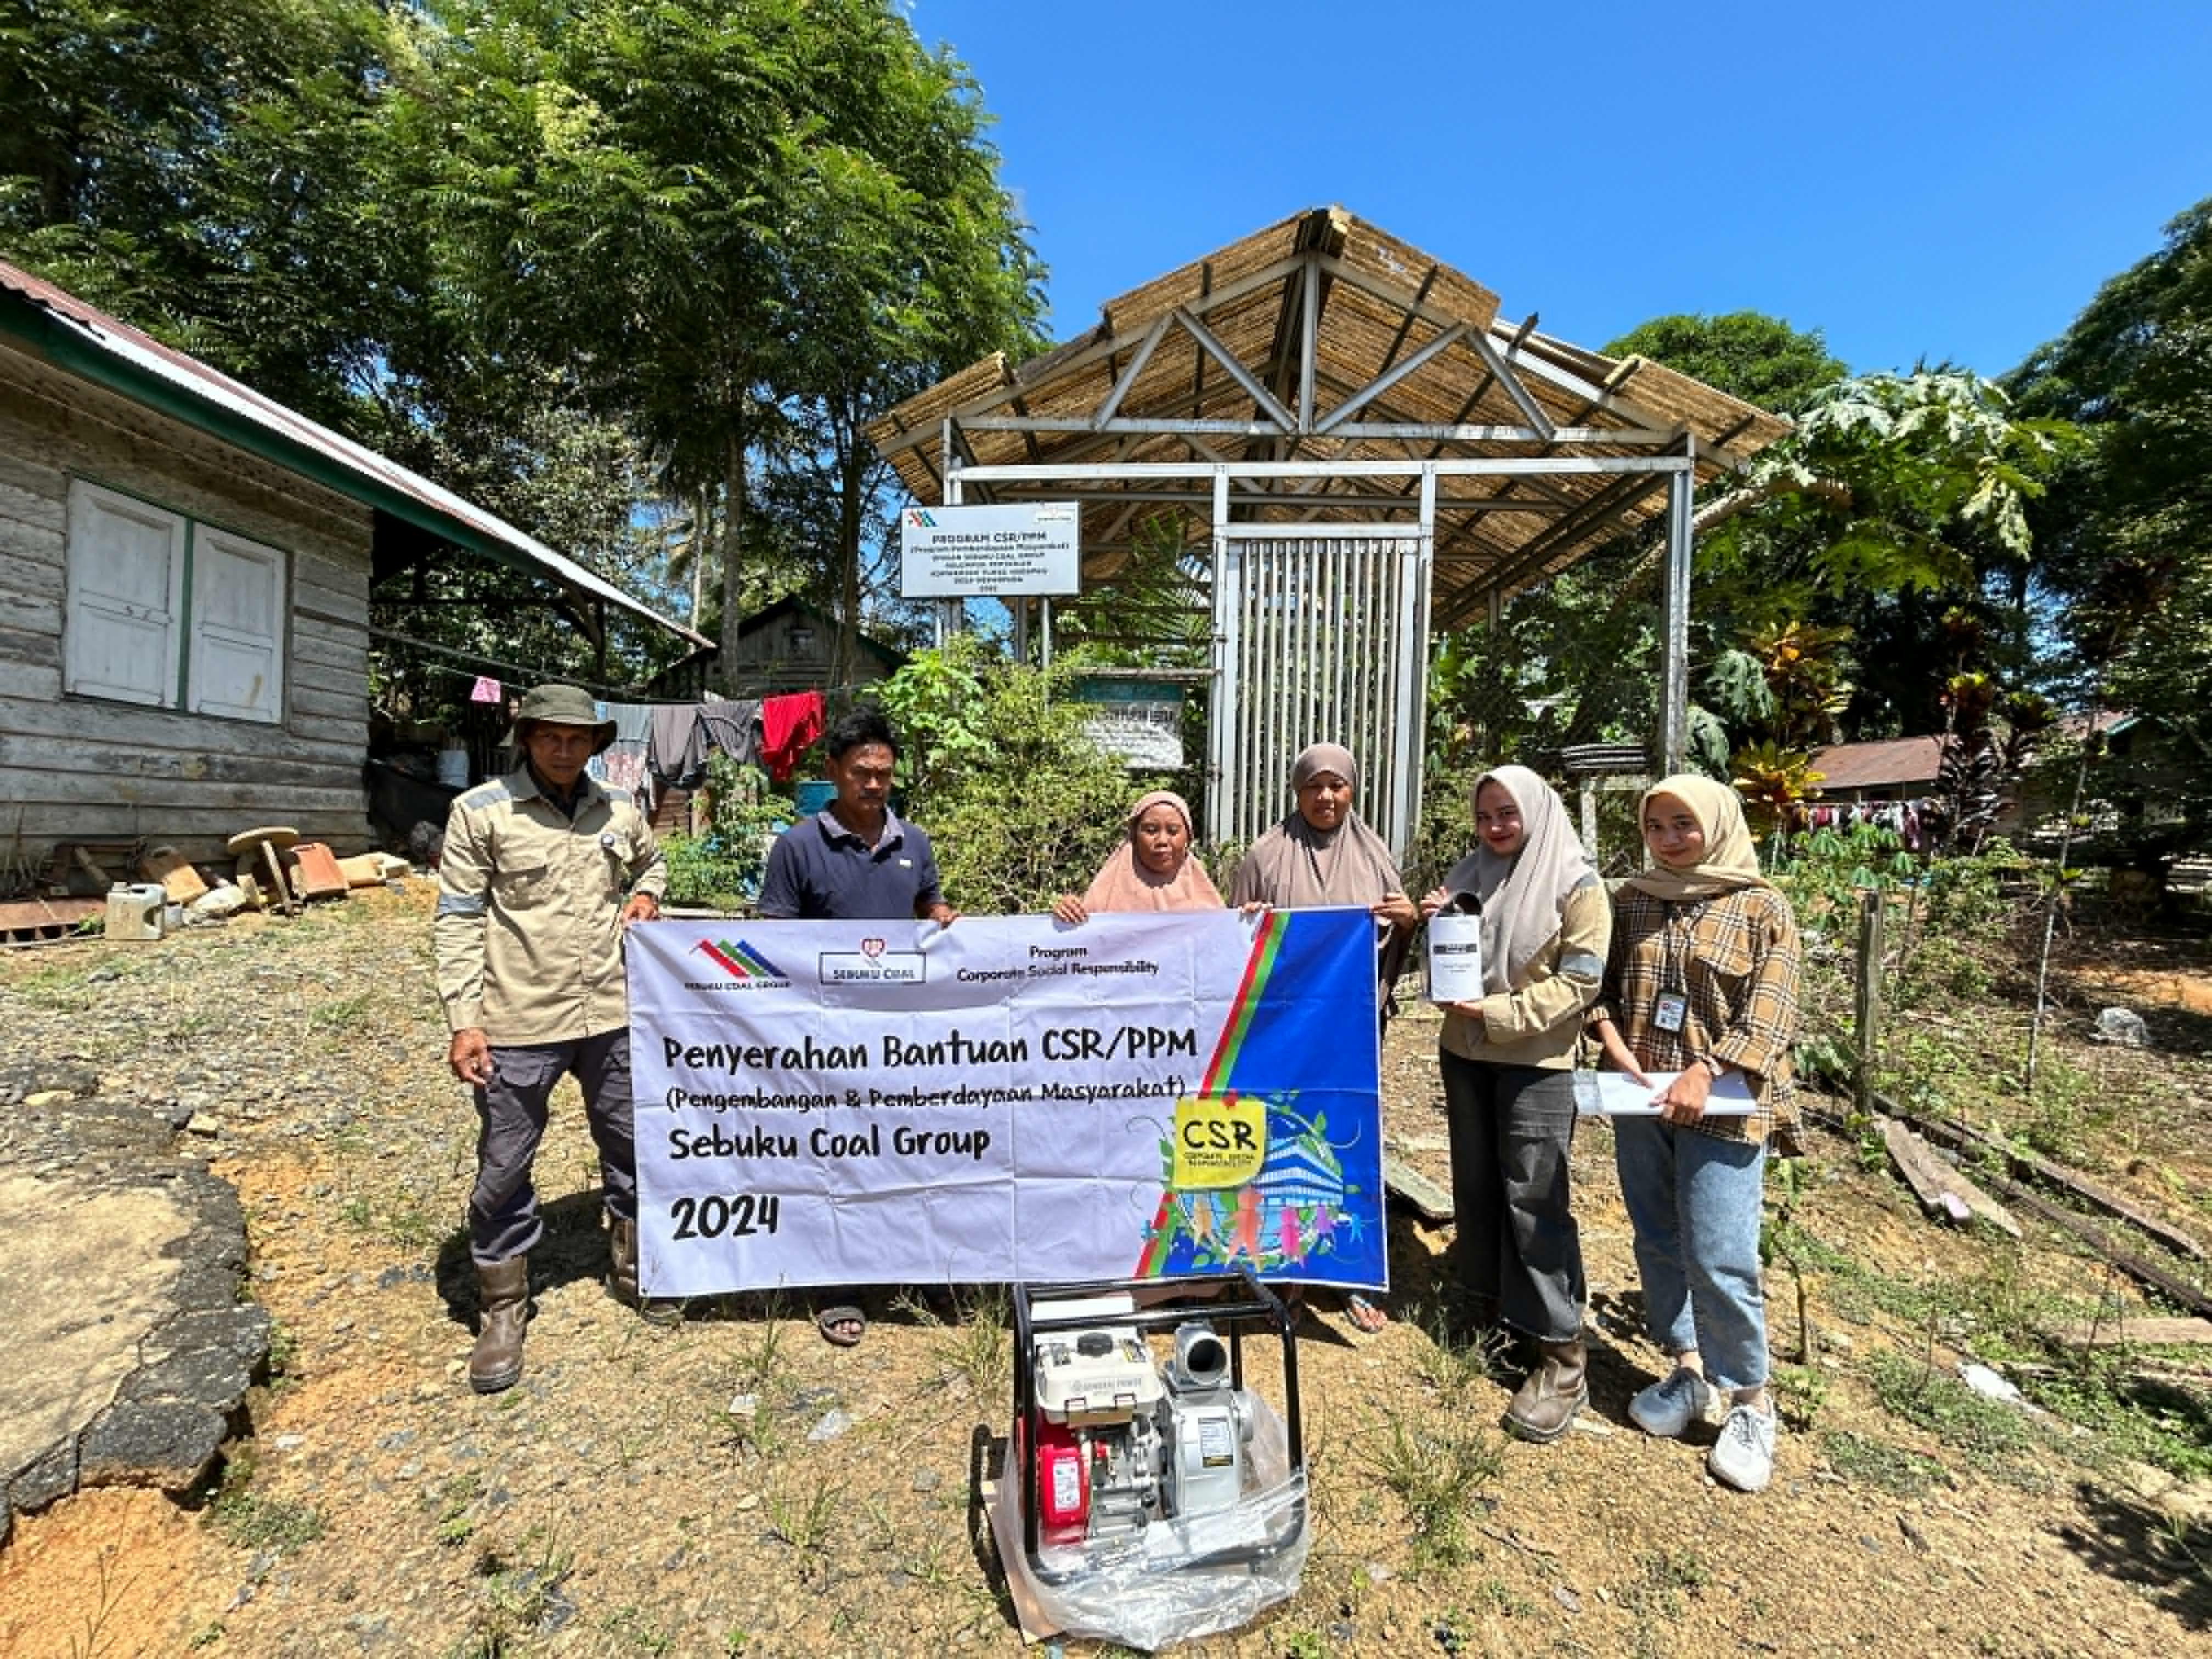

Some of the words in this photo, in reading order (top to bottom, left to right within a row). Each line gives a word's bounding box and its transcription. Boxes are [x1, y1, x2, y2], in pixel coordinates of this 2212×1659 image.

[932, 534, 990, 544] PROGRAM
[1030, 945, 1087, 961] Program
[957, 969, 1025, 983] Corporate
[1028, 964, 1068, 977] Social
[1071, 961, 1159, 976] Responsibility
[663, 1035, 867, 1076] Penyerahan
[883, 1029, 1028, 1068] Bantuan
[1042, 1027, 1197, 1061] CSR/PPM
[667, 1087, 837, 1114] (Pengembangan
[846, 1090, 861, 1107] &
[869, 1084, 1034, 1109] Pemberdayaan
[1040, 1076, 1185, 1104] Masyarakat)
[669, 1123, 798, 1159] Sebuku
[810, 1124, 881, 1158] Coal
[893, 1126, 990, 1160] Group
[1183, 1120, 1257, 1150] CSR
[671, 1194, 779, 1240] 2024
